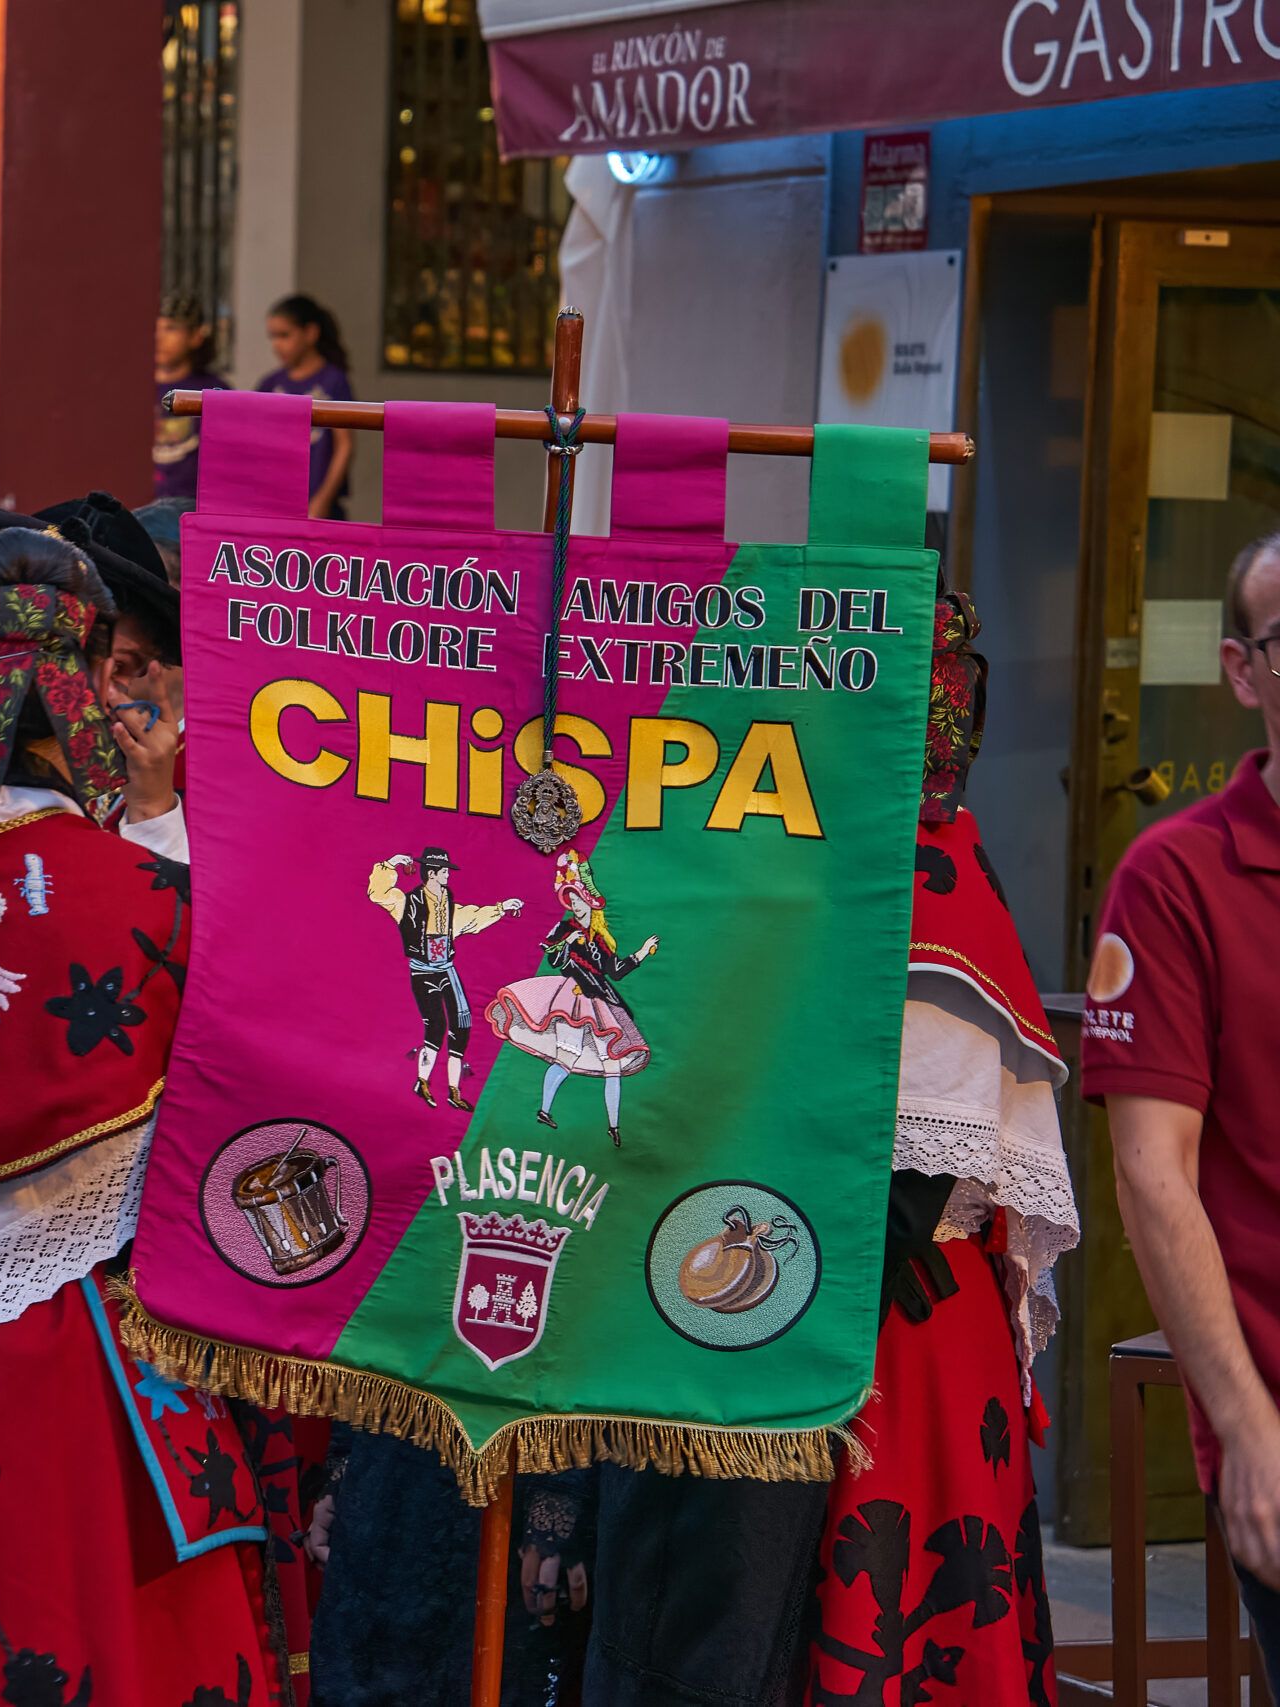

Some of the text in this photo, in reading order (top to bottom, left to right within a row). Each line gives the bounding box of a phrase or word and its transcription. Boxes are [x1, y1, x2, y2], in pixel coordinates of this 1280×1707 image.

[592, 22, 726, 73] EL RINCÓN DE
[558, 62, 755, 142] AMADOR
[208, 541, 903, 635] ASOCIACIÓN AMIGOS DEL
[227, 598, 878, 692] FOLKLORE EXTREMEÑO
[429, 1147, 610, 1231] PLASENCIA
